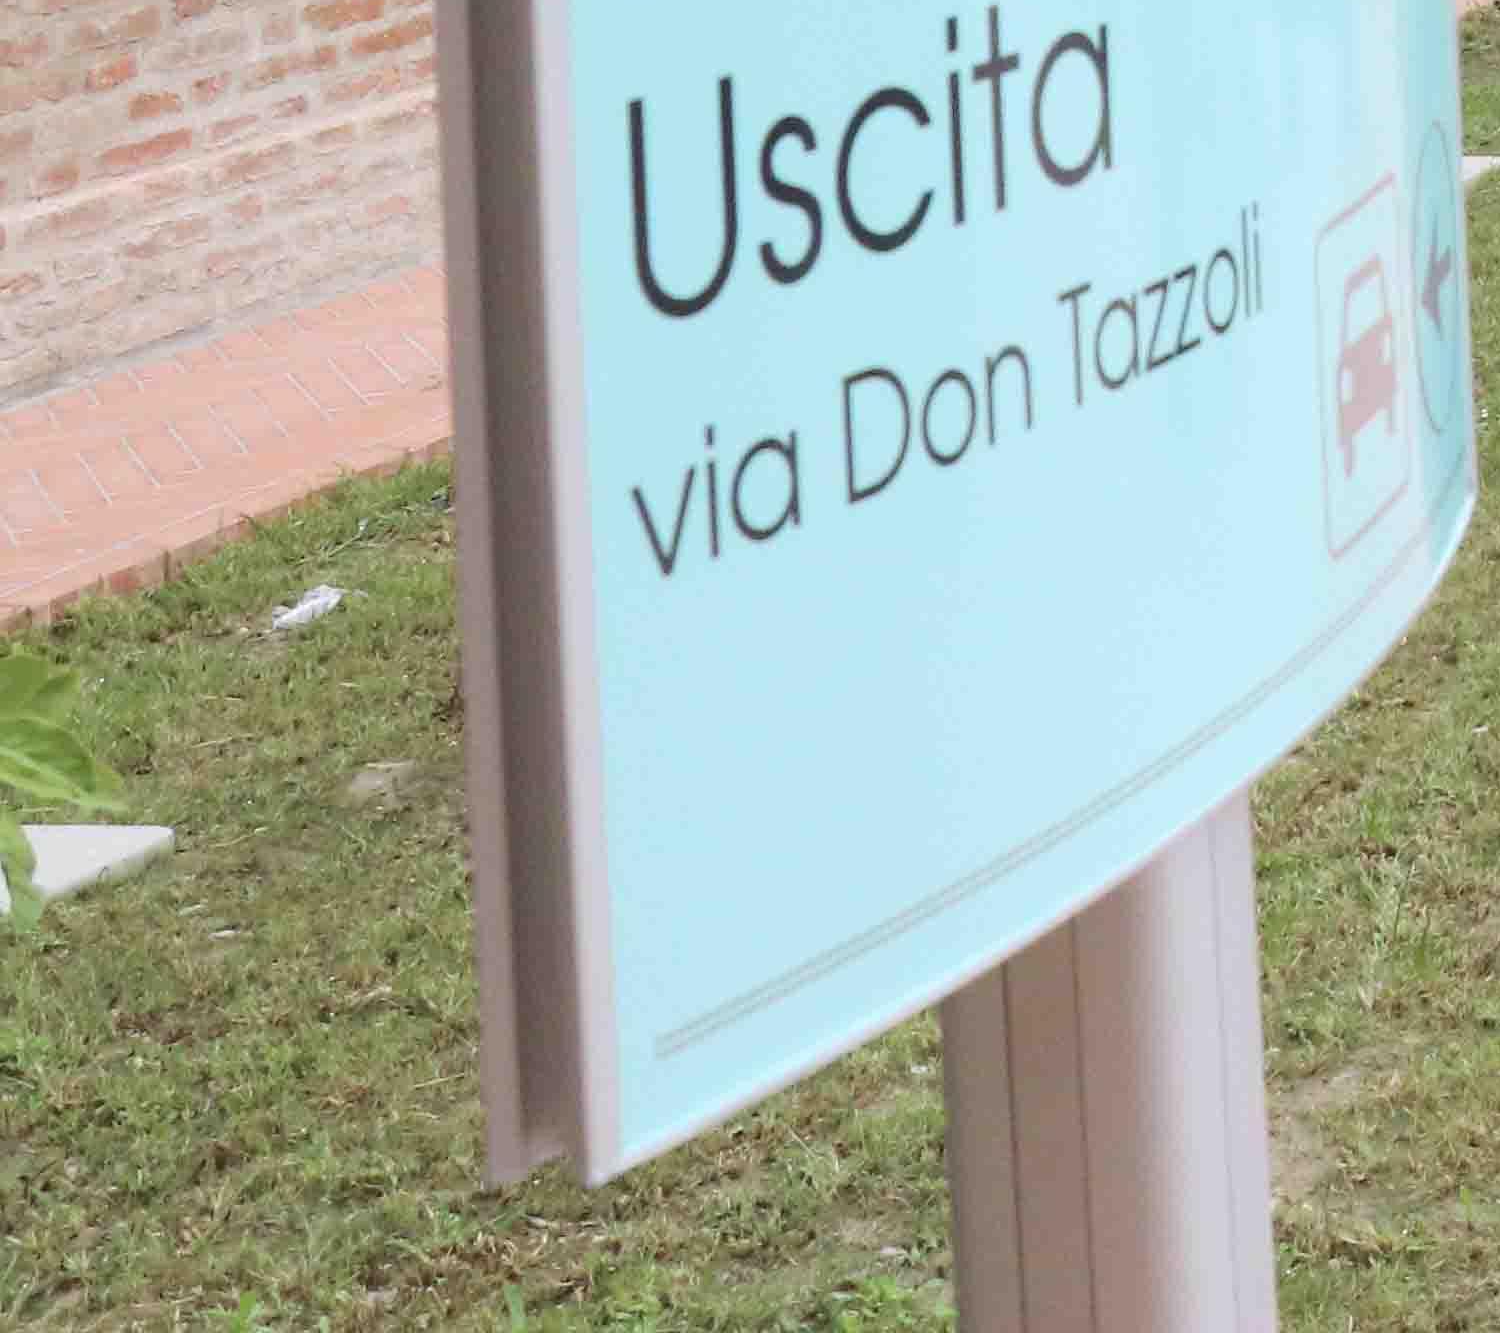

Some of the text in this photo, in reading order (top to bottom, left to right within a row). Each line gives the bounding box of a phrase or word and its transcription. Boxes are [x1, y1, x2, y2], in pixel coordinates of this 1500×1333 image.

[627, 3, 1116, 318] Uscita
[630, 201, 1266, 579] via Don Tazzoli
